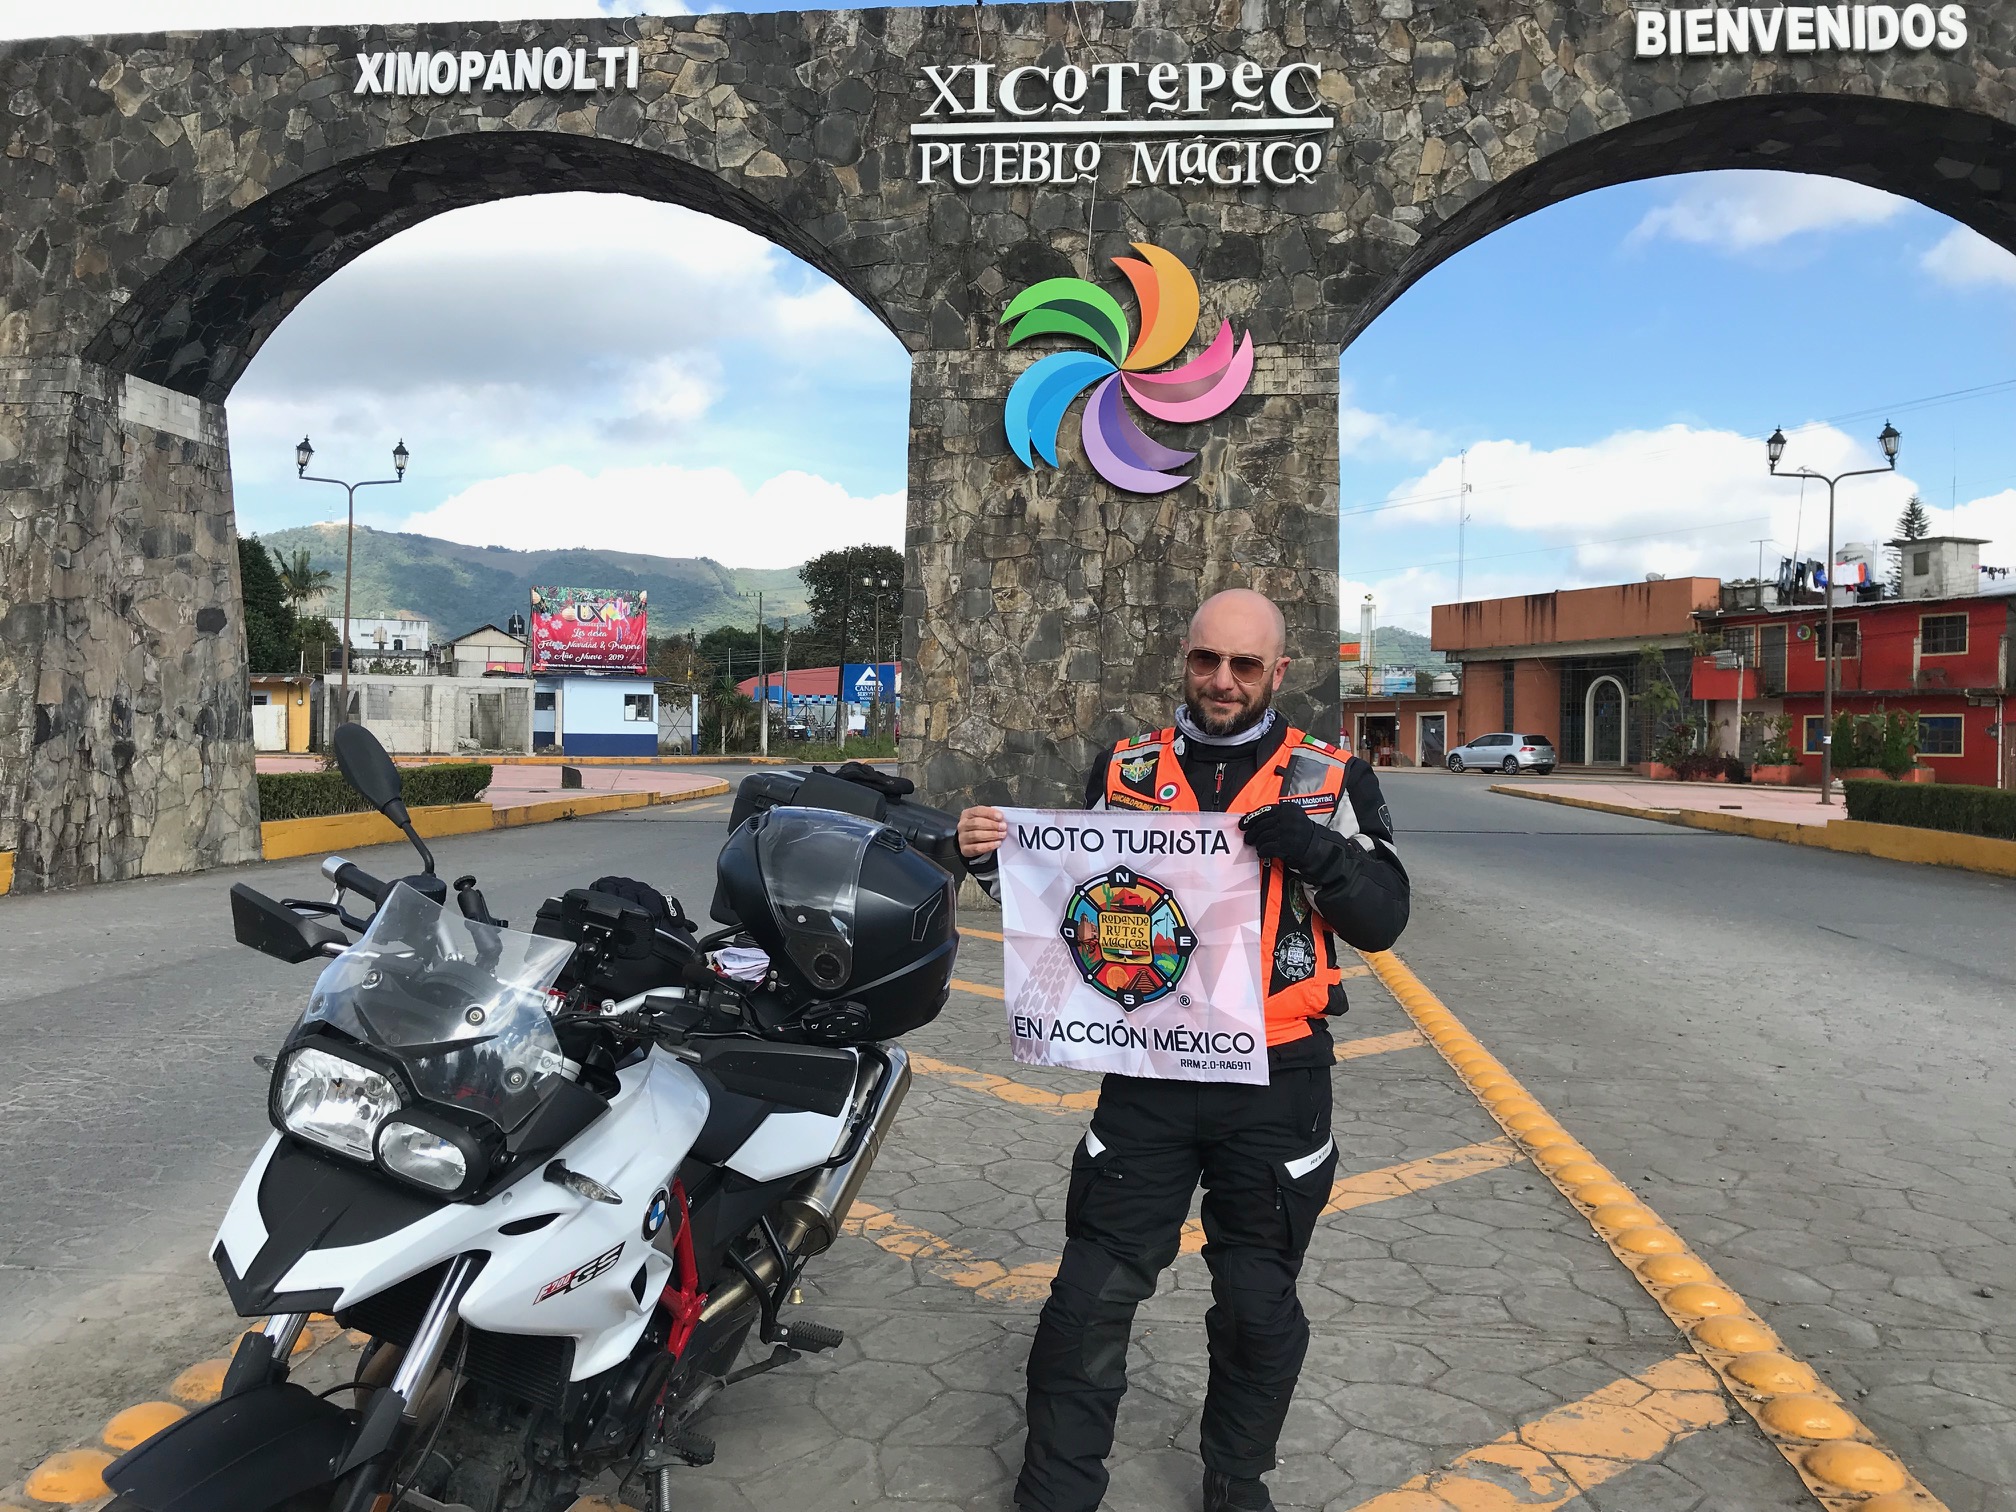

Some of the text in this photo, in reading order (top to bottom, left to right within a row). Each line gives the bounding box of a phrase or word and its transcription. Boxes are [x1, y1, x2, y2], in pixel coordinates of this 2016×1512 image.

[1635, 3, 1968, 57] BIENVENIDOS
[353, 47, 639, 95] XIMOPANOLTI
[538, 640, 559, 649] Feli
[562, 640, 598, 650] Navidad
[608, 653, 624, 661] 2019
[1302, 795, 1333, 805] Motorrad
[1018, 825, 1231, 855] MOTO TURISTA
[1115, 872, 1130, 883] N
[1063, 928, 1075, 938] O
[1179, 936, 1192, 947] E
[1123, 994, 1135, 1005] S
[1014, 1016, 1256, 1054] EN ACCIÓN MÉXICO
[1180, 1058, 1251, 1071] RRM 2.0-RA6911
